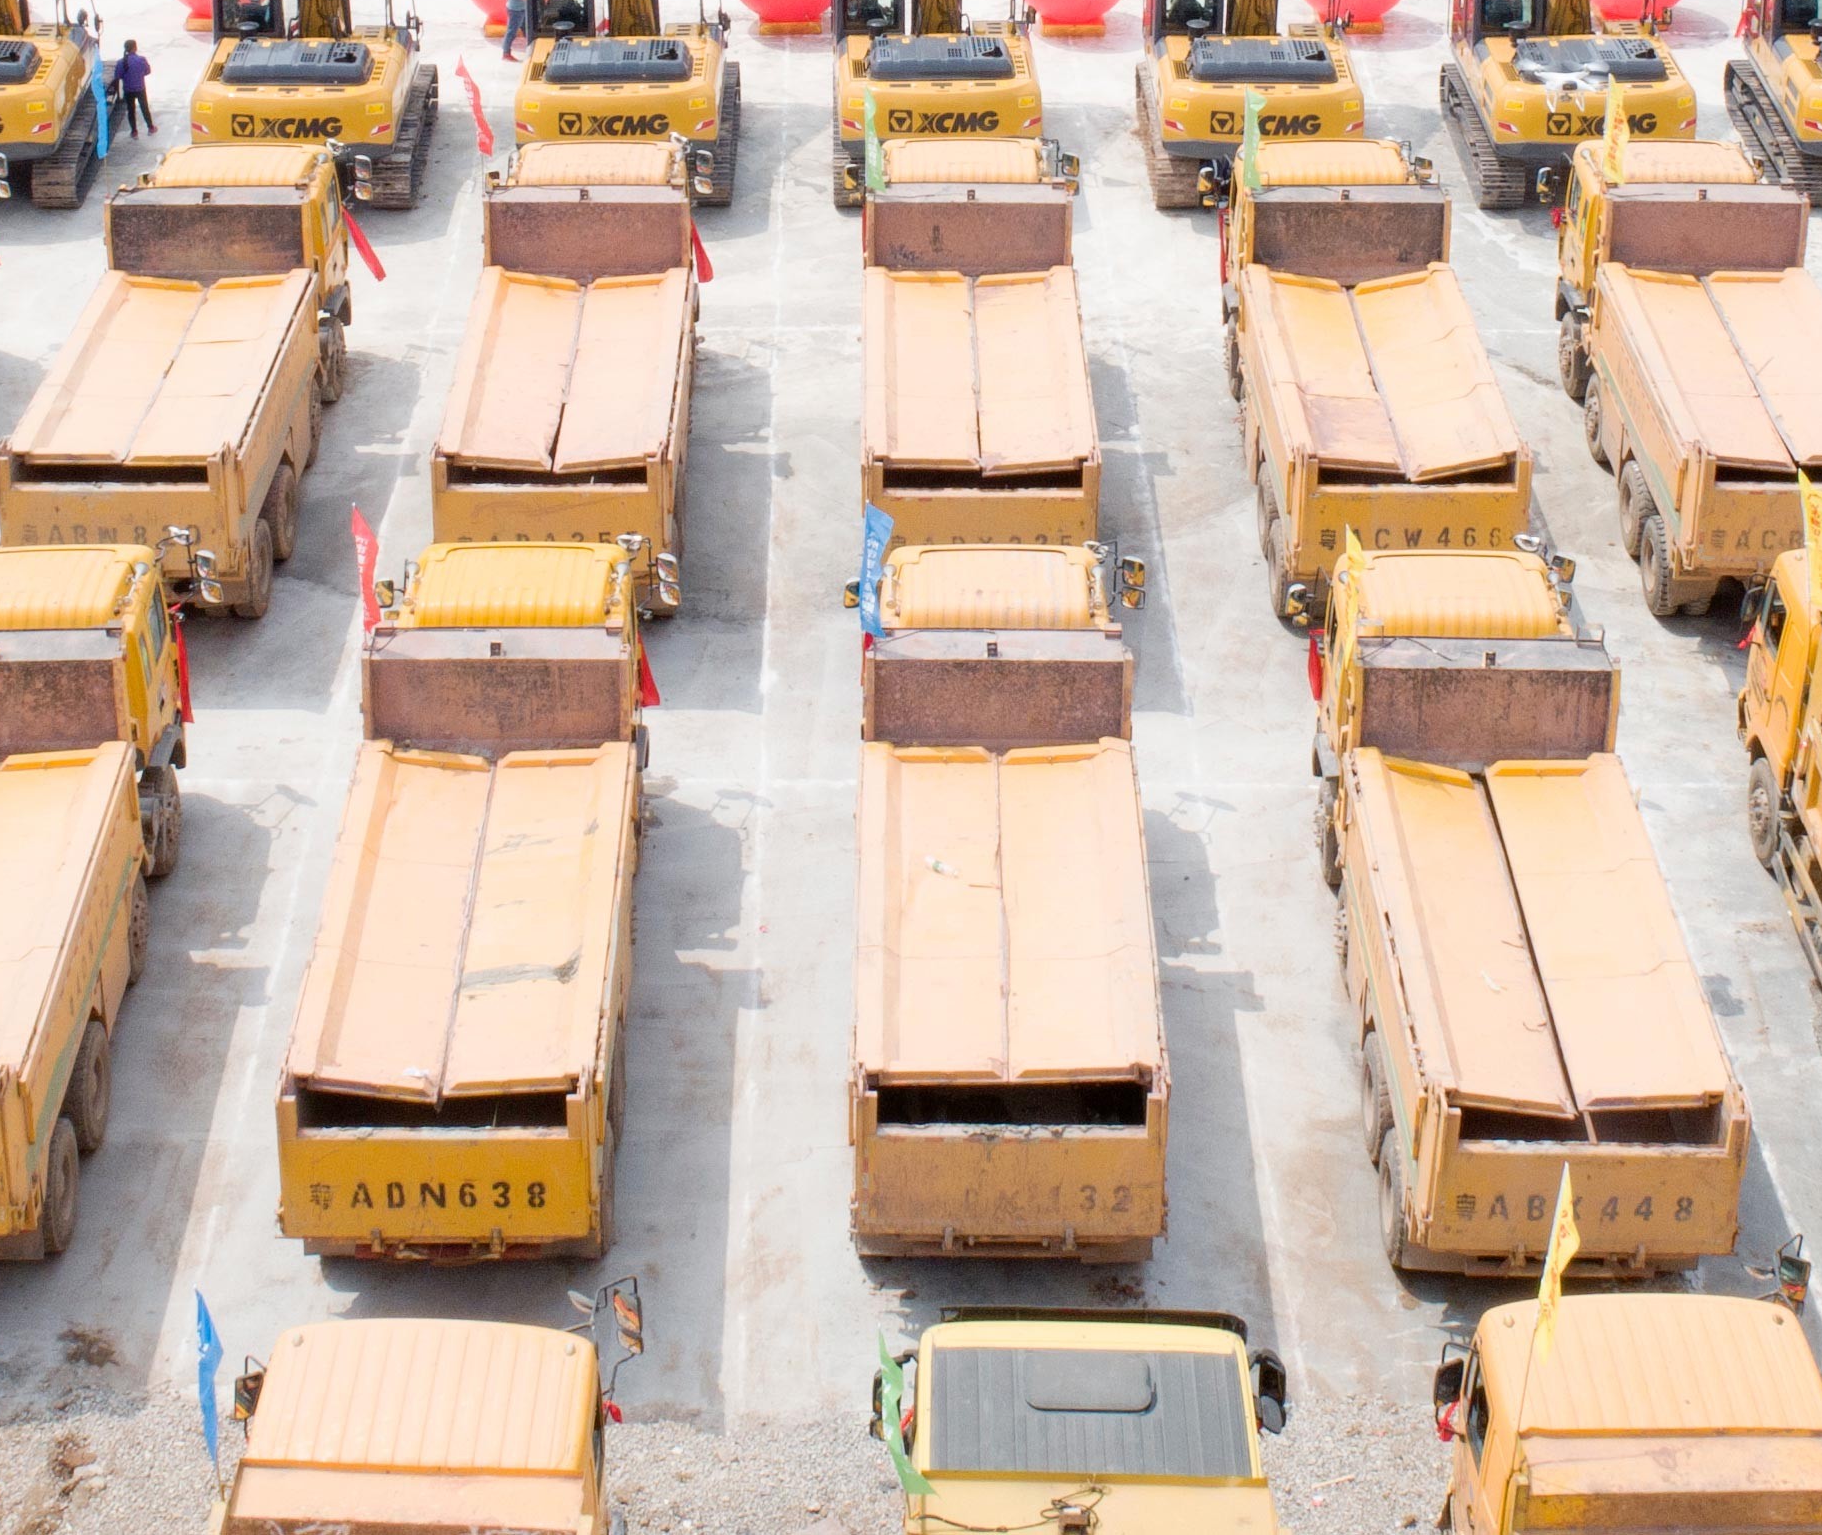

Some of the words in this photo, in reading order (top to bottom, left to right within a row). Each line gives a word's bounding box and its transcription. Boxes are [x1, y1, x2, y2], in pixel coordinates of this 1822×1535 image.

[258, 116, 343, 138] XCMG
[587, 113, 669, 135] XCMG
[915, 111, 999, 133] XCMG
[309, 1180, 547, 1212] 粤ADN638
